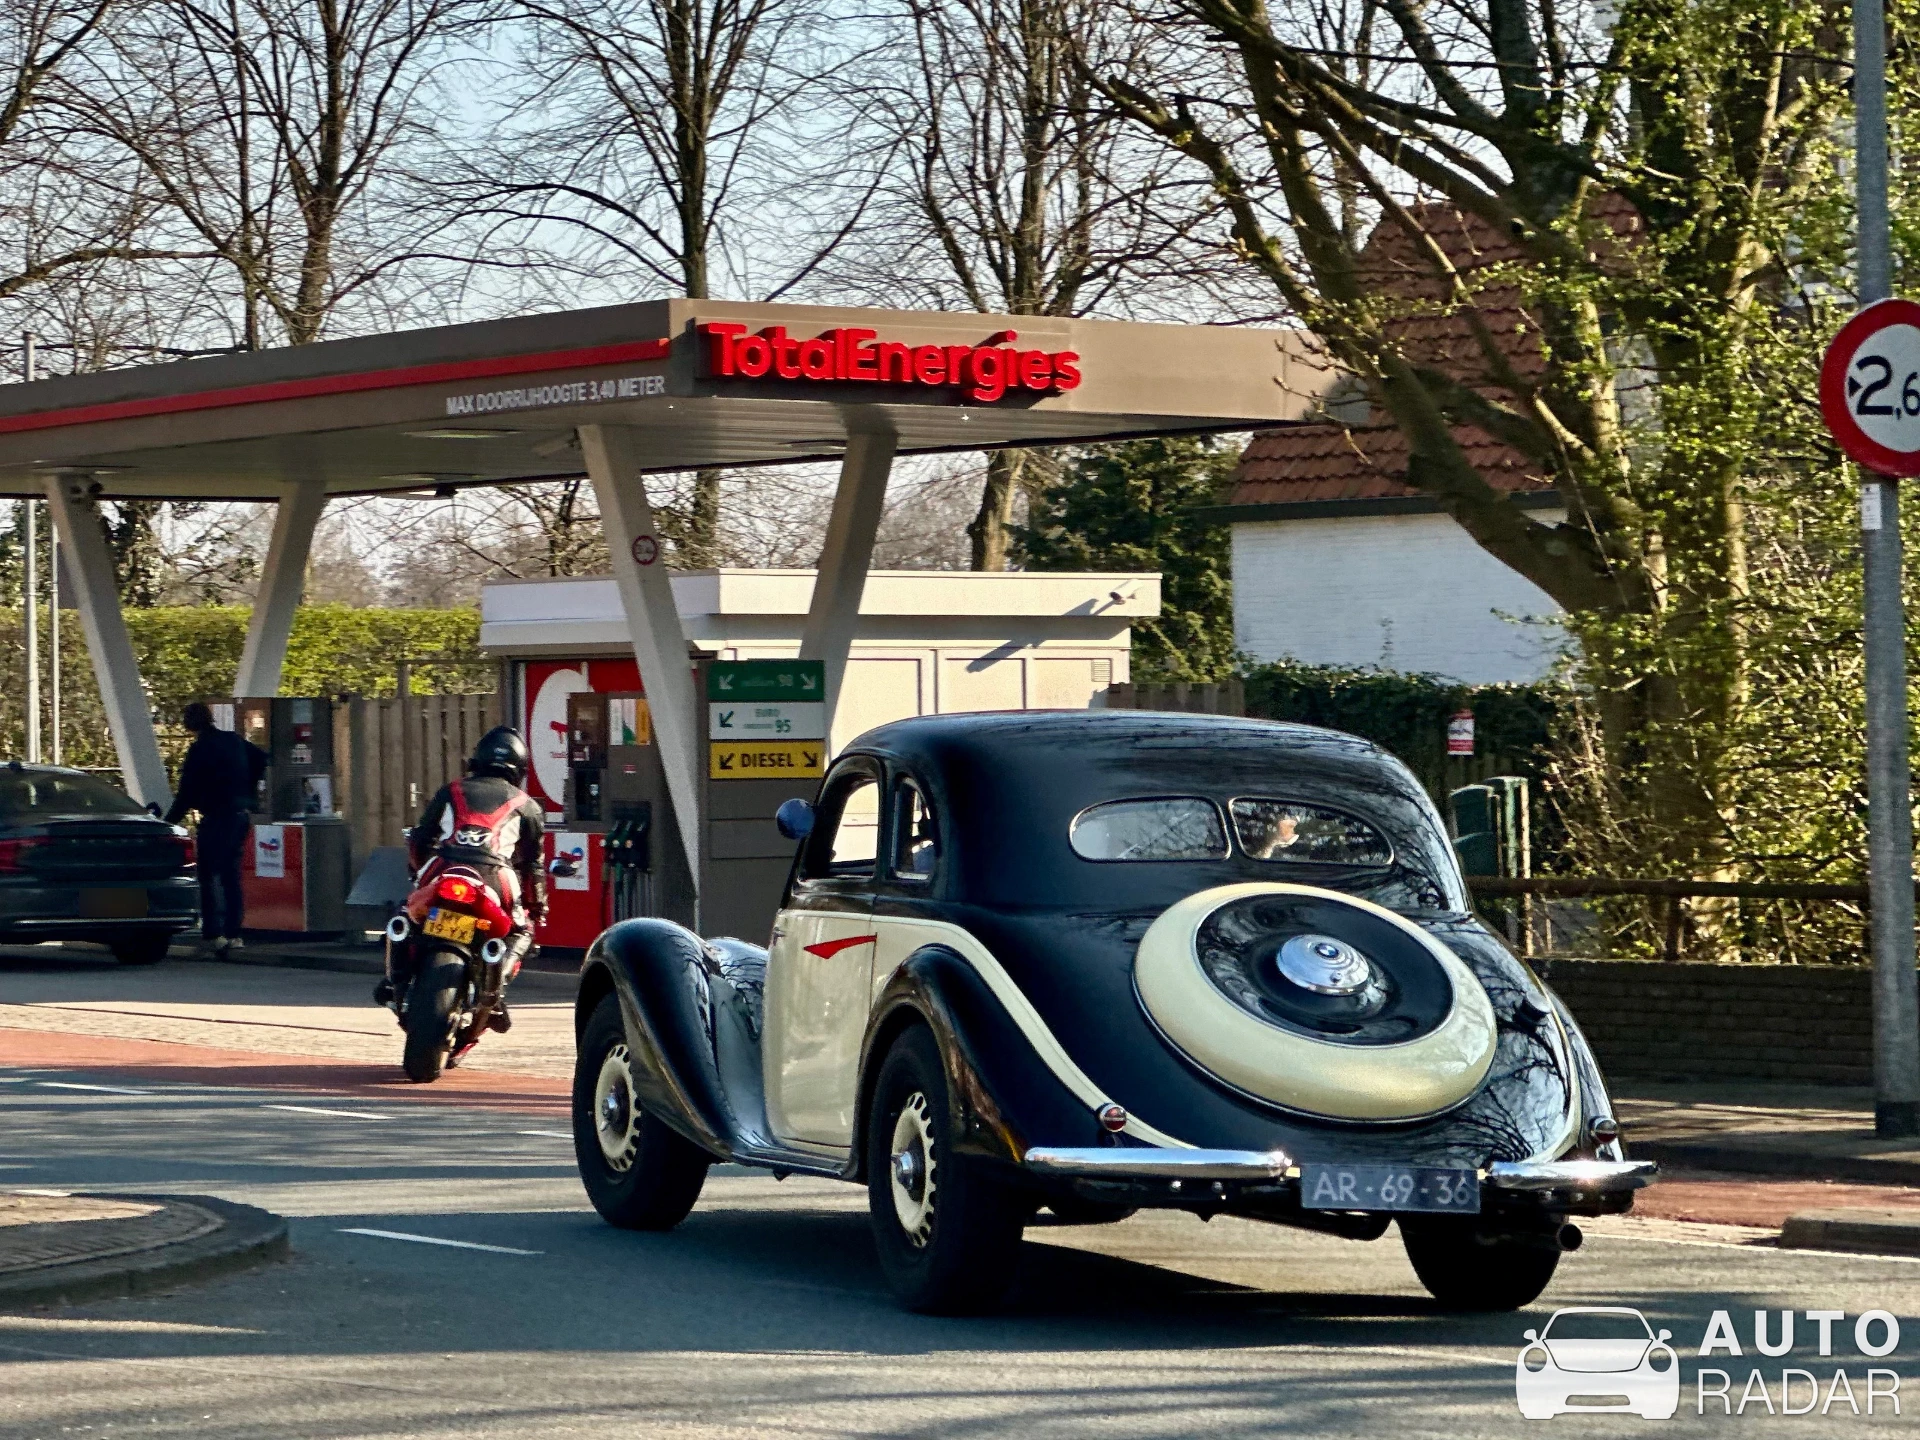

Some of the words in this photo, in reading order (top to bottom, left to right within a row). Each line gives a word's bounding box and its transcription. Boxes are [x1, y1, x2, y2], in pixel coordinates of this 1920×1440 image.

[704, 322, 1082, 402] TotalEnergies
[446, 394, 475, 415] MAX
[617, 375, 665, 398] METER
[741, 752, 795, 768] DIESEL
